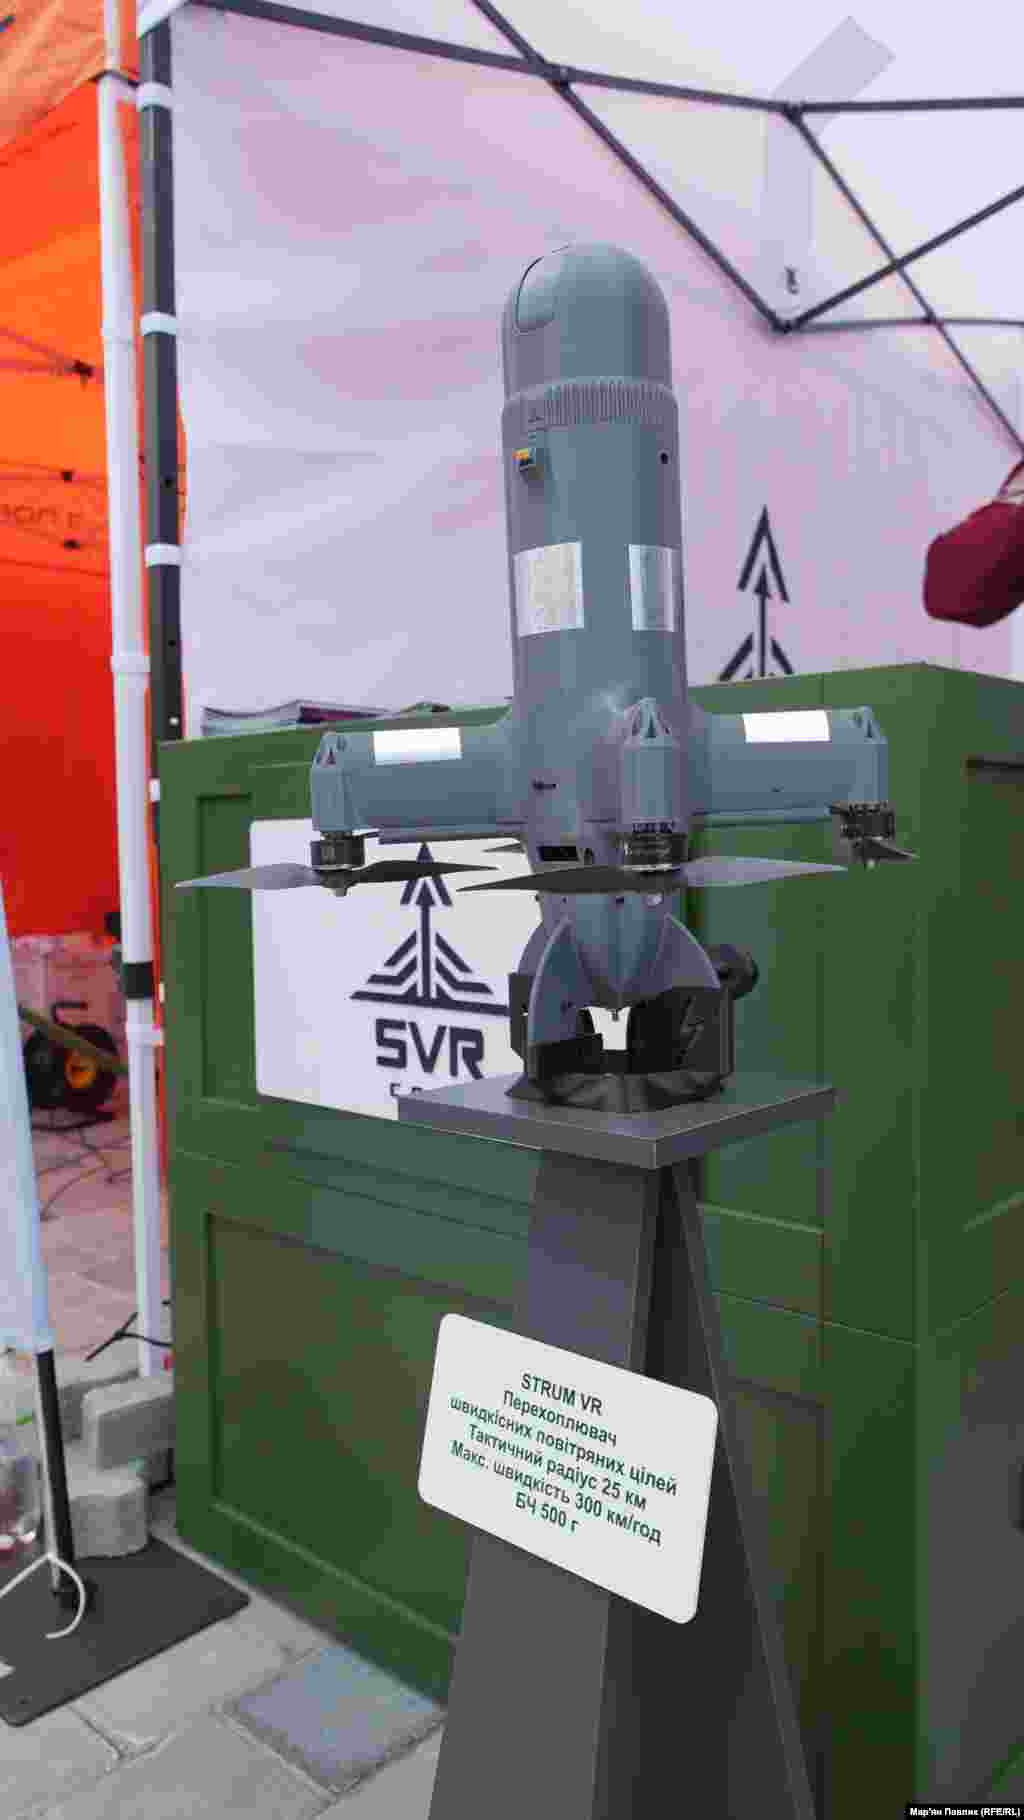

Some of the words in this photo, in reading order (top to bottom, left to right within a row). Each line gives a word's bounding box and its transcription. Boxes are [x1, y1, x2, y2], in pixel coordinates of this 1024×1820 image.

[376, 1018, 484, 1080] SVR
[503, 1390, 617, 1447] Перехоплювач
[521, 1373, 576, 1407] STRUM
[580, 1392, 603, 1415] VR
[450, 1396, 533, 1438] швидкісних
[536, 1430, 625, 1475] повітряних
[630, 1465, 678, 1496] цілей
[469, 1423, 543, 1467] Тактичний
[547, 1459, 598, 1489] радіус
[602, 1478, 621, 1499] 25
[625, 1490, 647, 1510] км
[451, 1439, 489, 1470] Макс.
[494, 1460, 570, 1504] швидкість
[575, 1491, 602, 1517] 300
[607, 1509, 661, 1547] км/год
[515, 1491, 537, 1515] БЧ
[541, 1502, 567, 1528] 500
[570, 1519, 579, 1532] г
